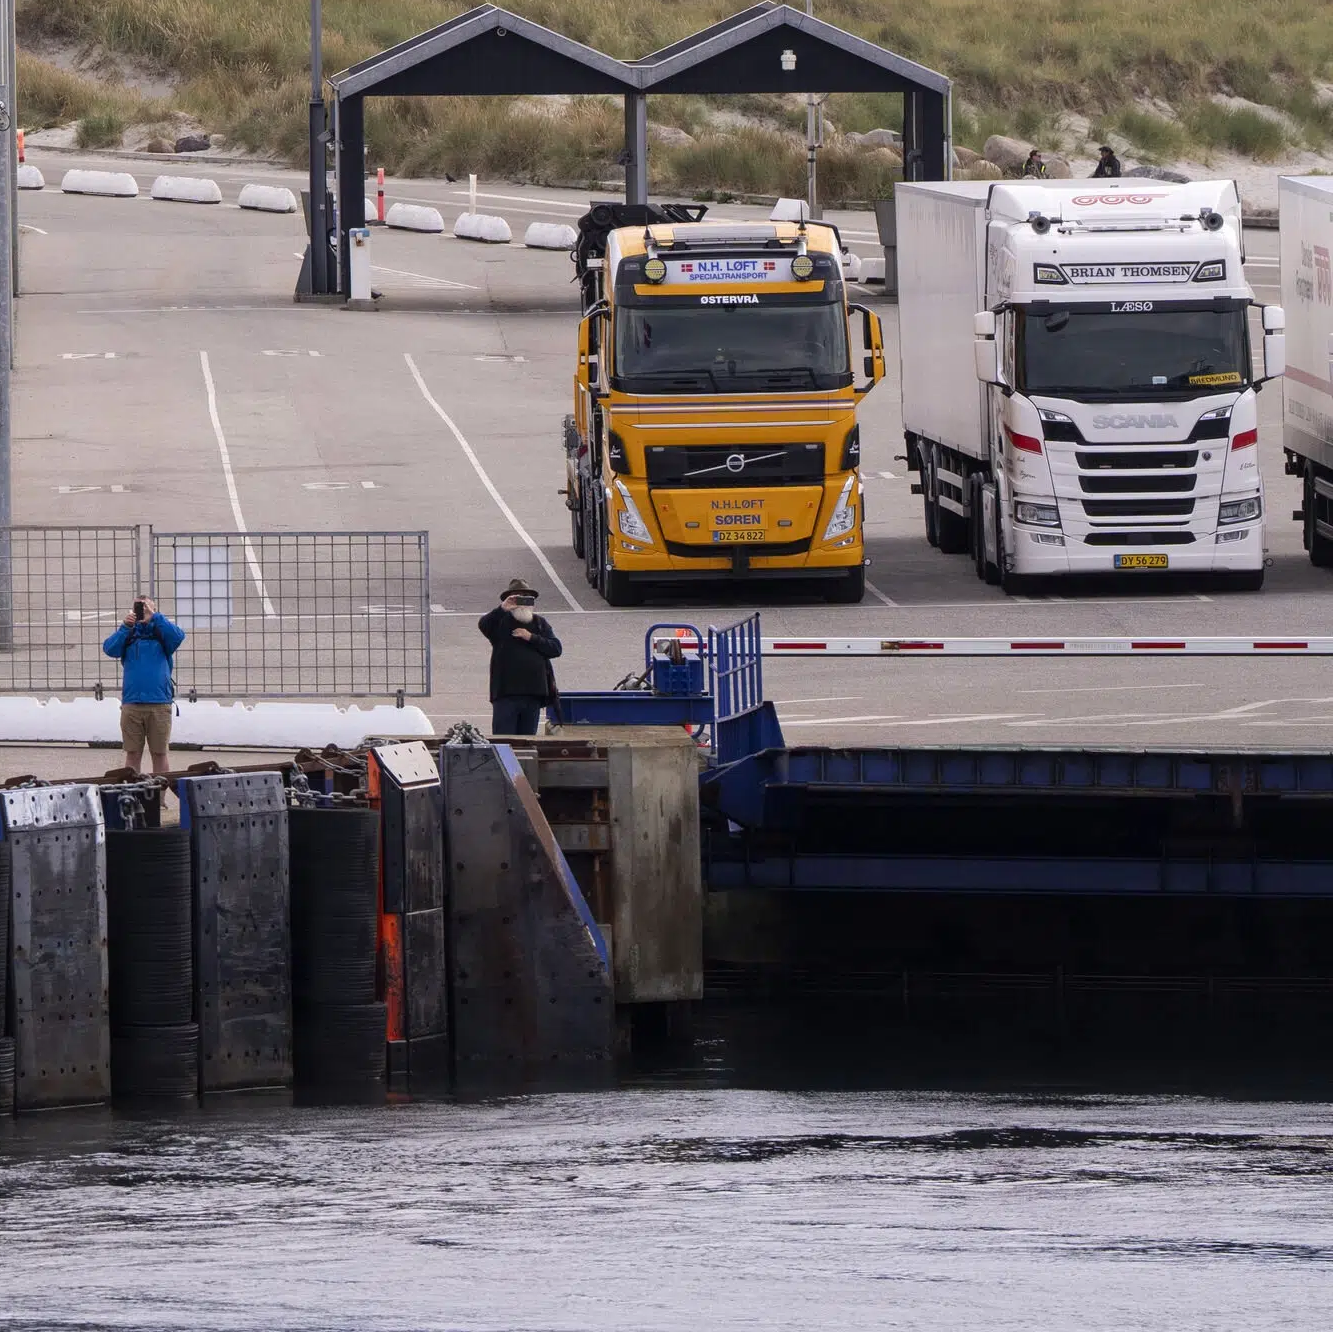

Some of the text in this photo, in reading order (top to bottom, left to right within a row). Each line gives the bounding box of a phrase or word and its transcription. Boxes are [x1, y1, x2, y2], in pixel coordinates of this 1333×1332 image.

[698, 260, 758, 272] N.H. LØFT
[1070, 265, 1191, 278] BRIAN THOMSEN
[689, 272, 768, 281] SPECIALTRANSPORT
[700, 293, 759, 305] ØSTERVRÅ
[1110, 301, 1153, 313] LÆSØ
[1092, 413, 1180, 430] SCANIA
[715, 514, 761, 525] SØREN
[719, 530, 764, 541] DZ 34 822
[1121, 555, 1166, 566] DY 56 279
